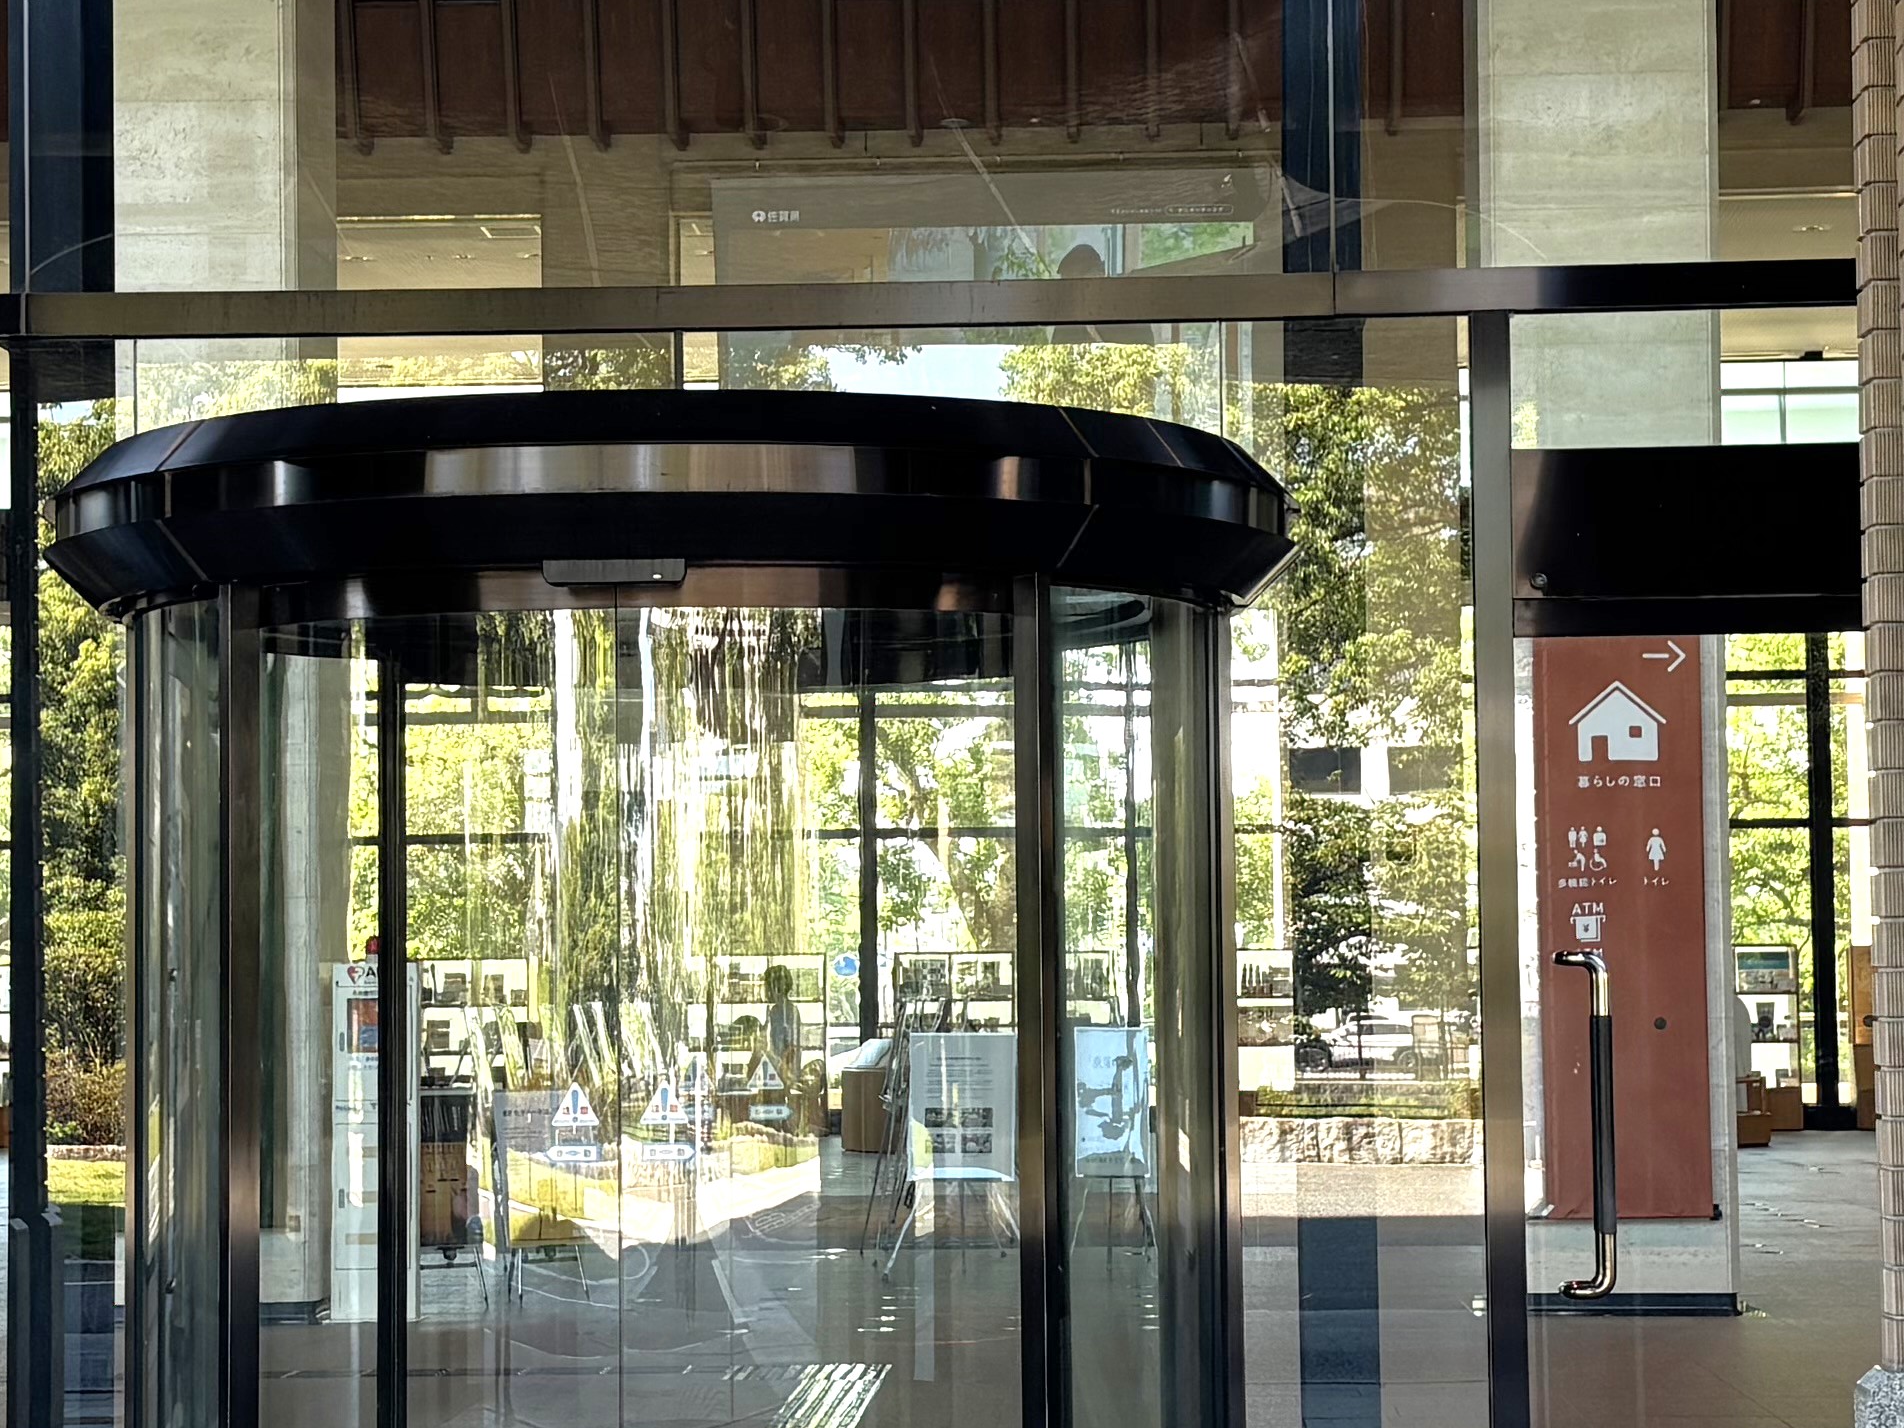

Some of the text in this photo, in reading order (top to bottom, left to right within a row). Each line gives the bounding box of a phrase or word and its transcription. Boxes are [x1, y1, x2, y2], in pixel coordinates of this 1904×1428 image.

[1577, 775, 1661, 788] 暮らしの窓口
[1643, 876, 1669, 887] トイレ
[1571, 902, 1604, 915] ATM
